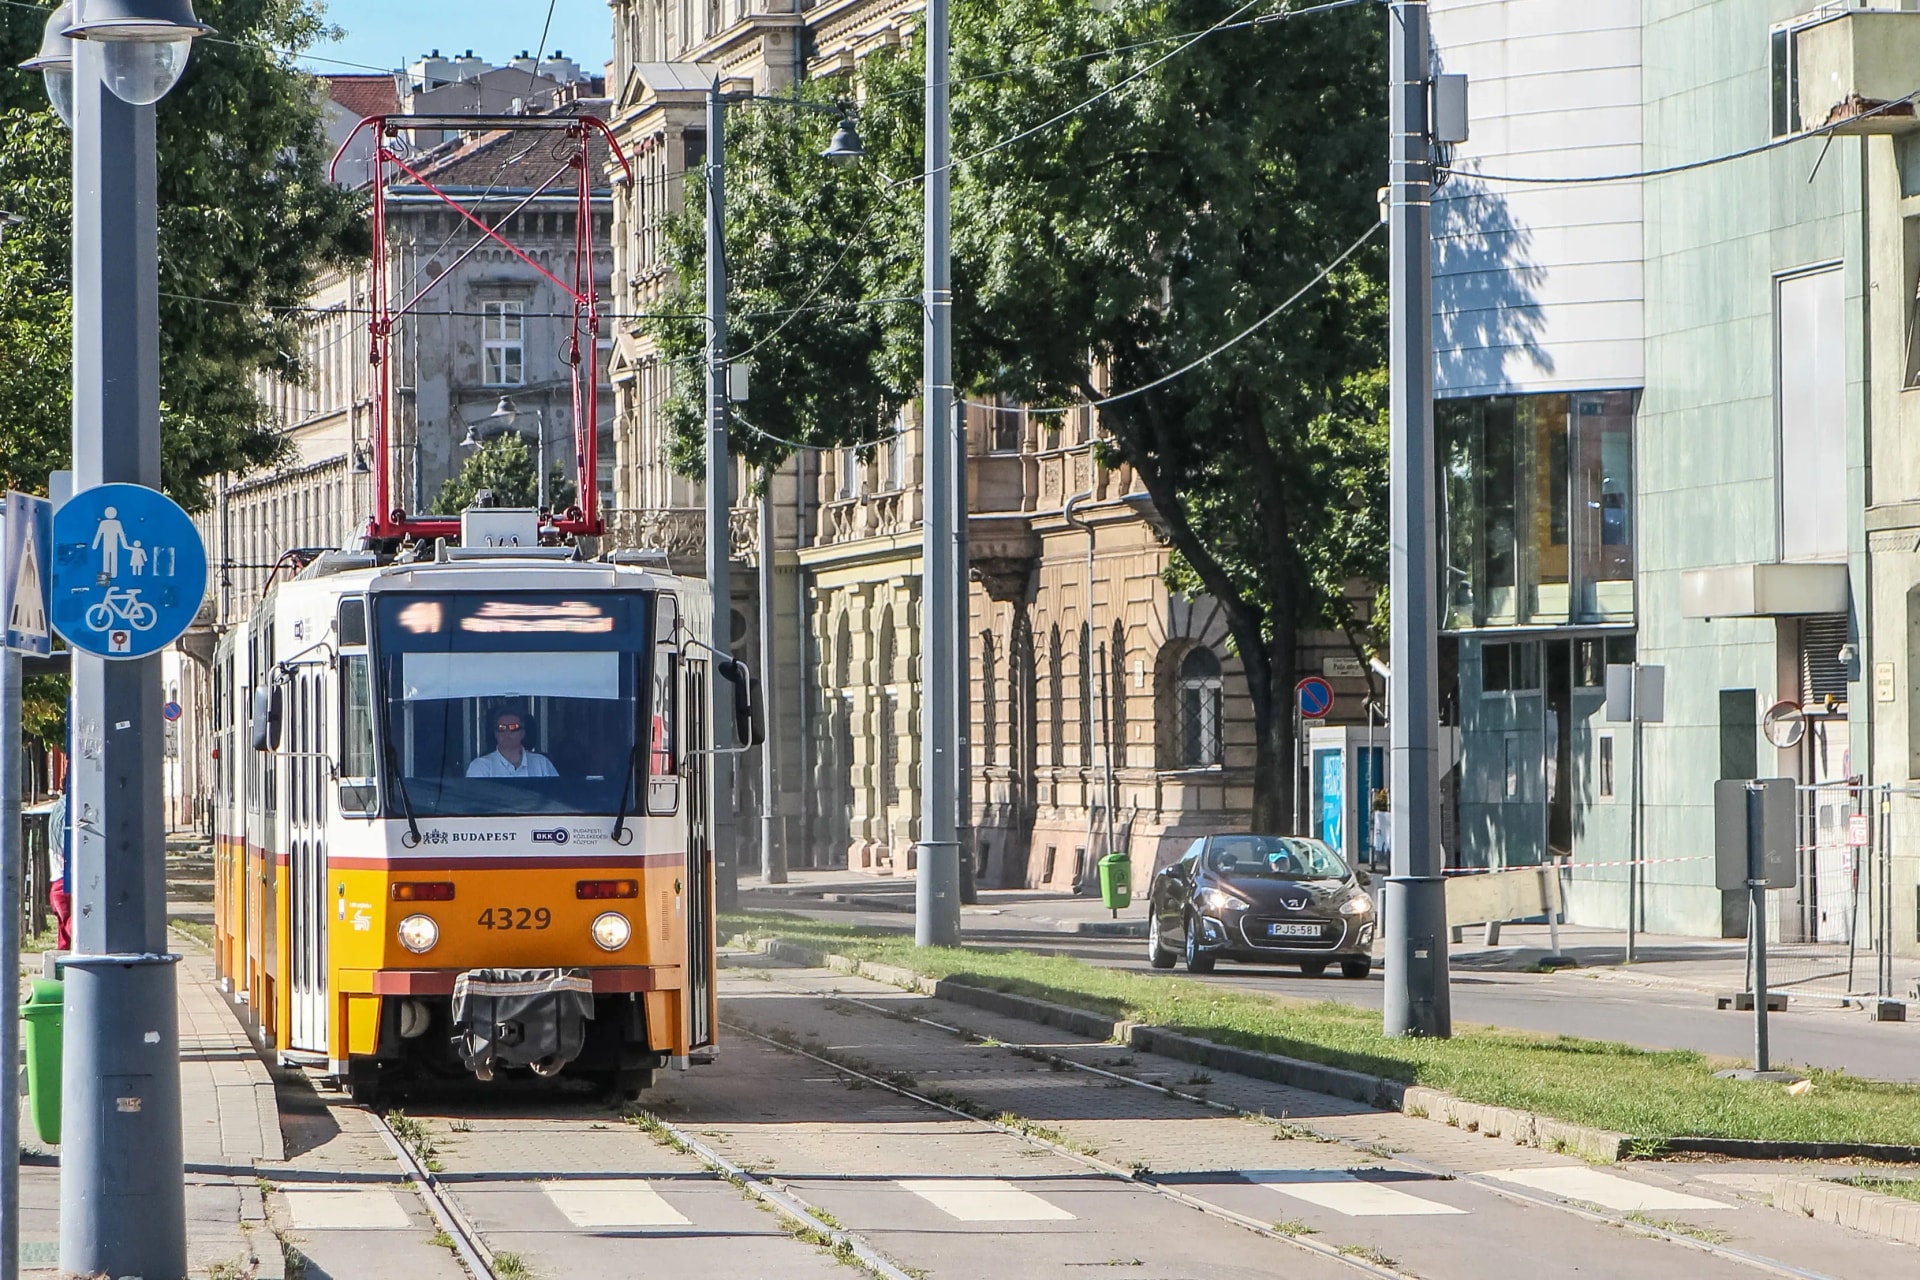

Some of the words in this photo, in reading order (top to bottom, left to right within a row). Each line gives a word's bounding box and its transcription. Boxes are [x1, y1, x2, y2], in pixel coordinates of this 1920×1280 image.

[452, 832, 517, 842] BUDAPEST
[477, 907, 552, 931] 4329
[1275, 925, 1319, 935] PJS-581
